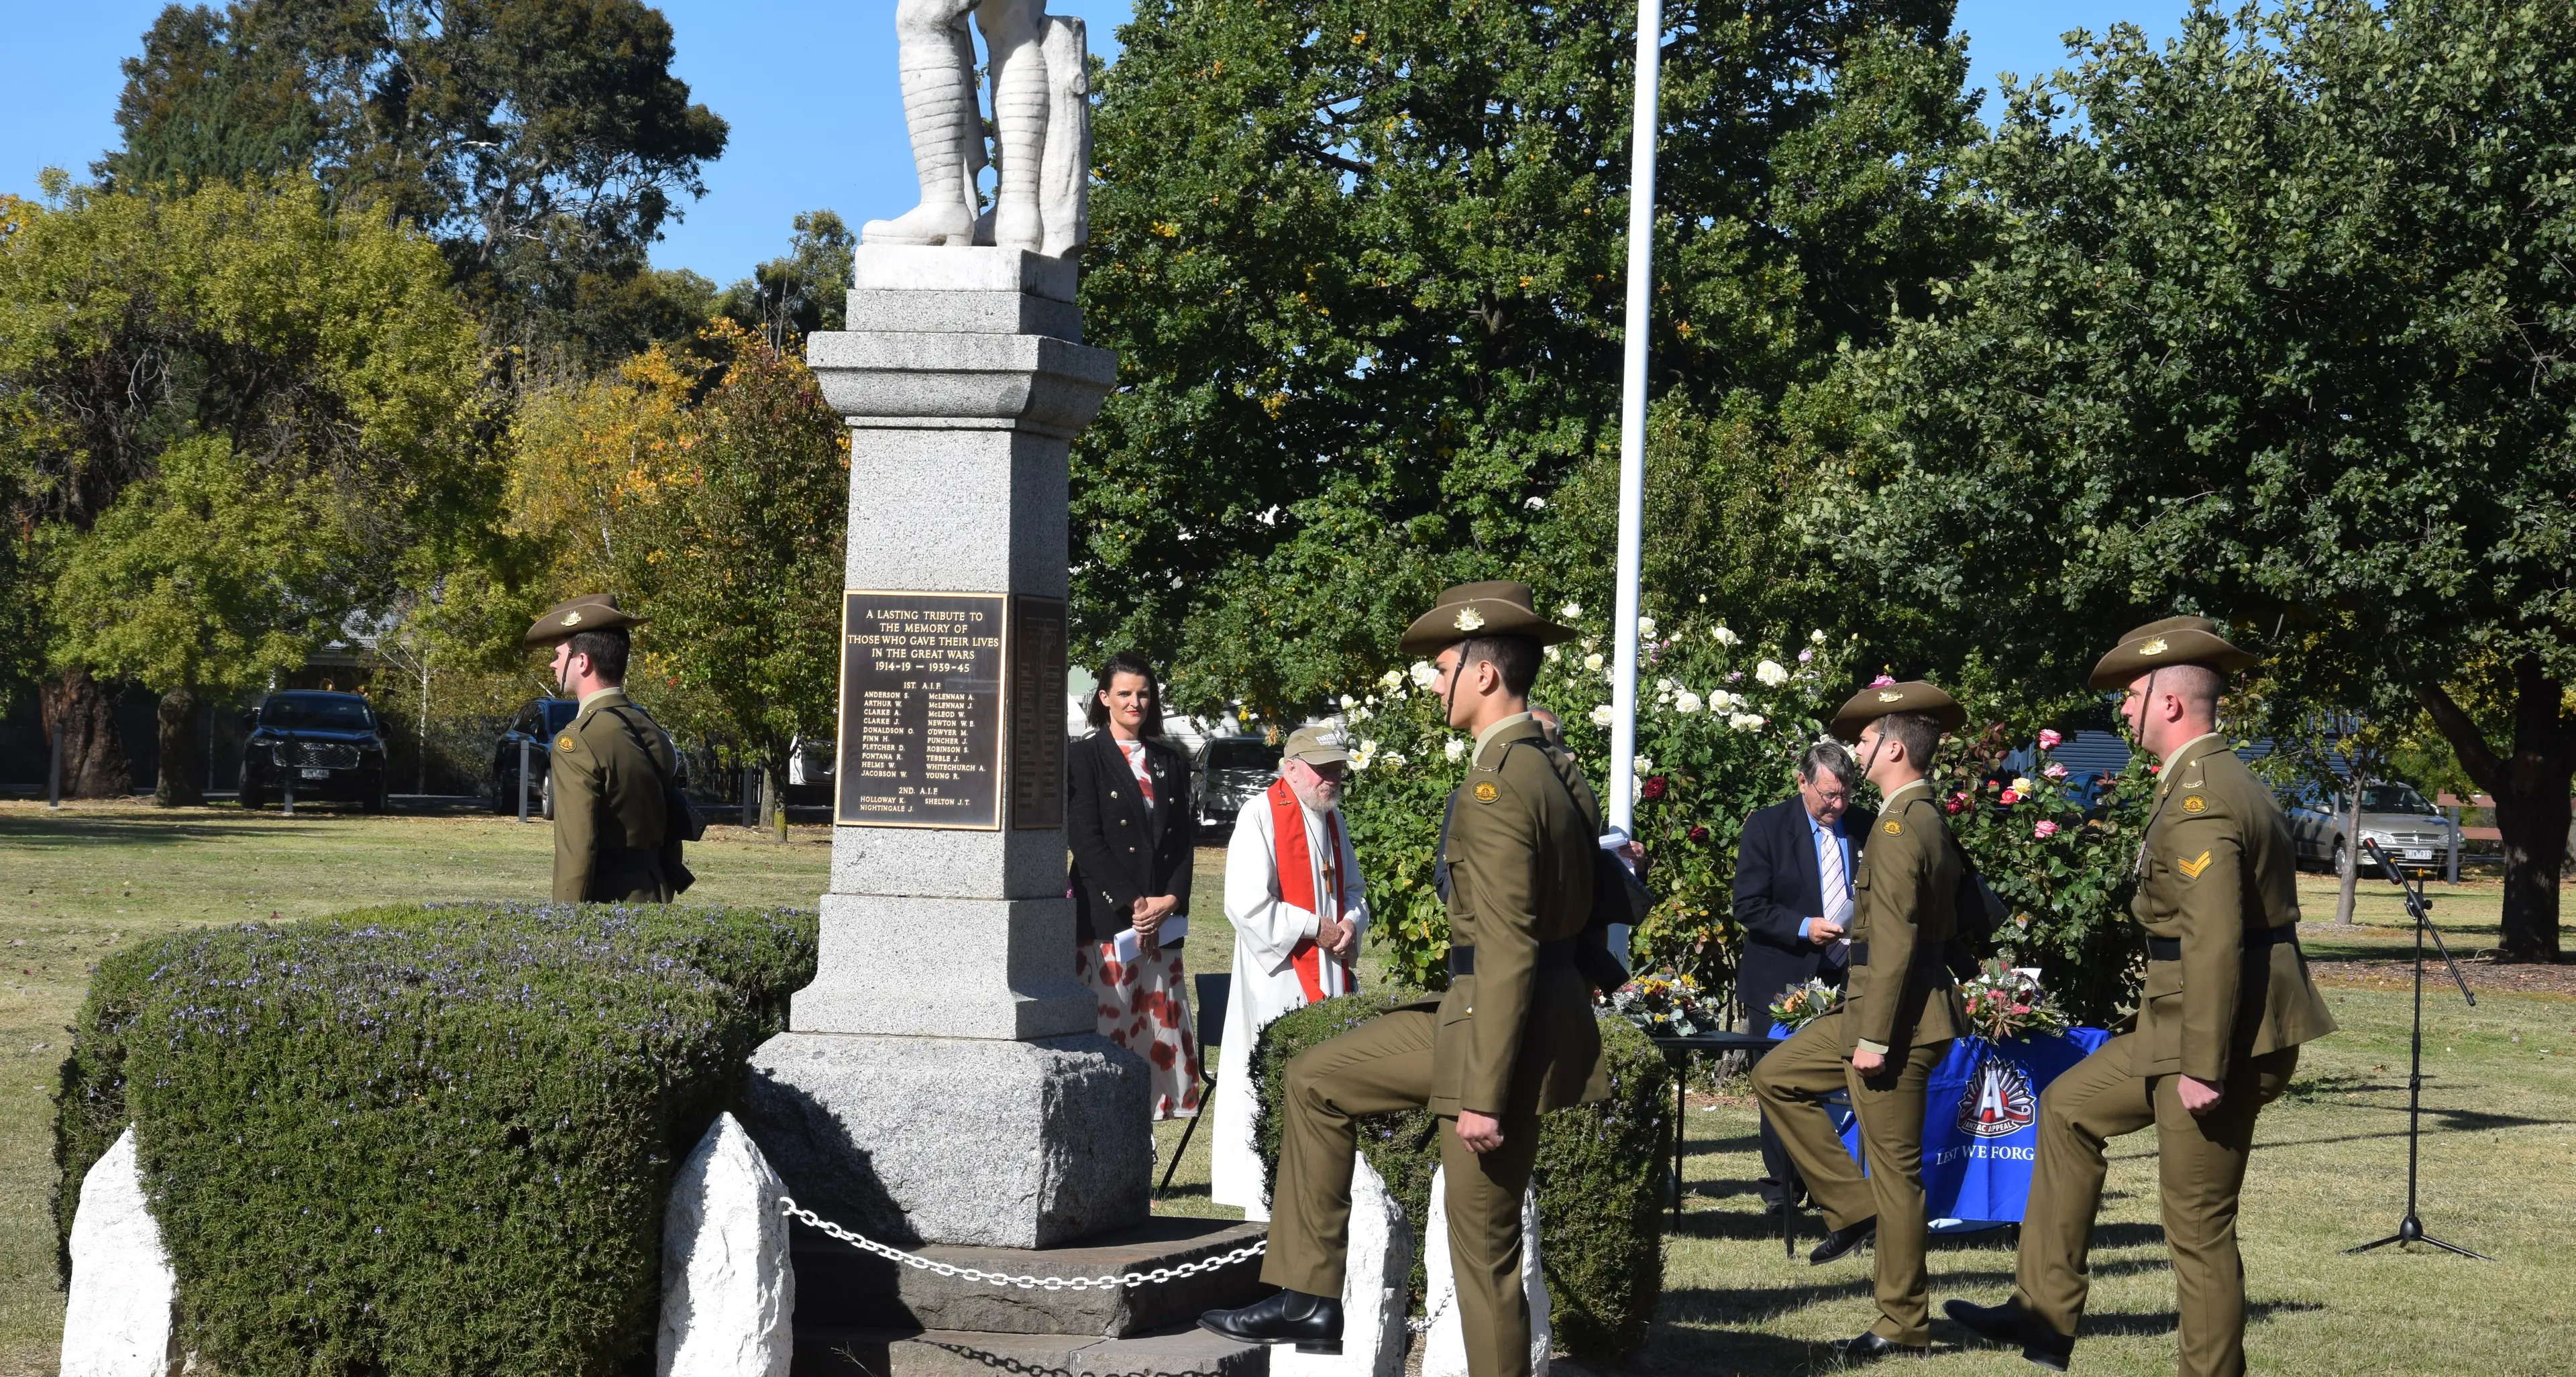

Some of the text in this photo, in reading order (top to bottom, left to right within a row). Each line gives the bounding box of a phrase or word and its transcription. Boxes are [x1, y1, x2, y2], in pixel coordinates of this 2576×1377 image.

[866, 610, 983, 622] A LASTING TRIBUTE TO
[879, 623, 967, 634] THE MEMORY OF
[848, 635, 999, 647] THOSE WHO GAVE THEIR LIVES
[872, 648, 975, 659] IN THE GREAT WARS
[875, 662, 911, 671] 1914-19
[929, 663, 970, 673] 1939-45
[926, 763, 975, 771] WHITECHURCH
[1965, 1121, 2012, 1132] ANZAC APPEAL
[1936, 1145, 2035, 1165] LEST WE FORG
